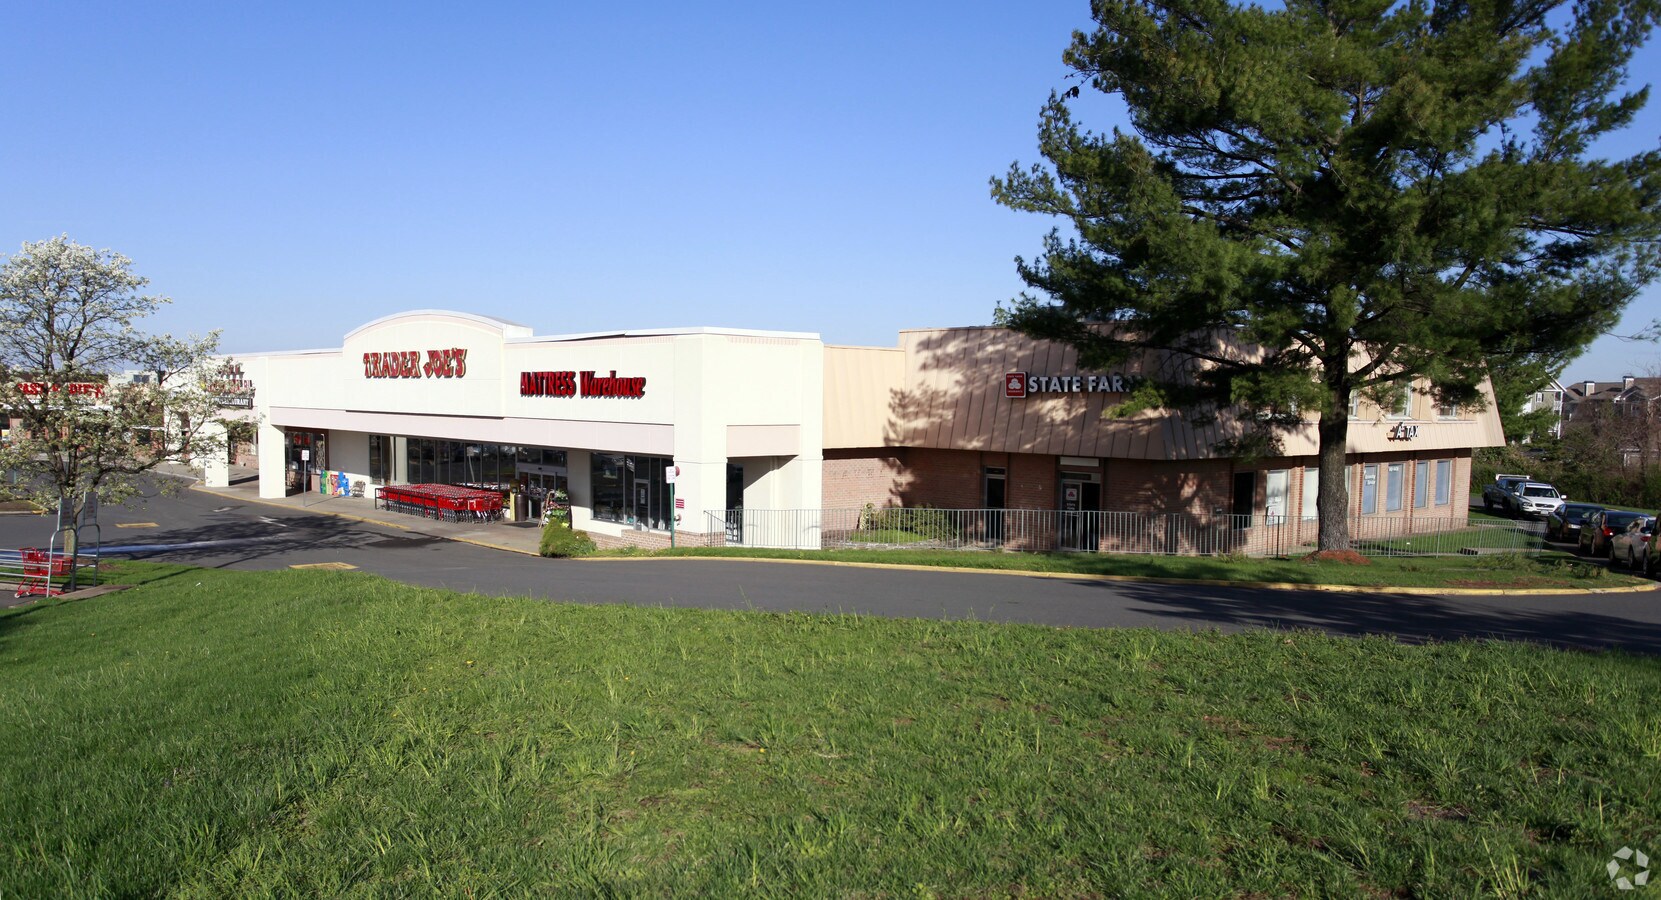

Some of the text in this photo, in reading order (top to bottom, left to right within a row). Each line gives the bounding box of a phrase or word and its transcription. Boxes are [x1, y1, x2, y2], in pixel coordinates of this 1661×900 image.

[363, 348, 467, 378] TRADER JOE'S
[520, 370, 646, 399] MATTRESS Warehouse
[1028, 376, 1081, 392] STATE
